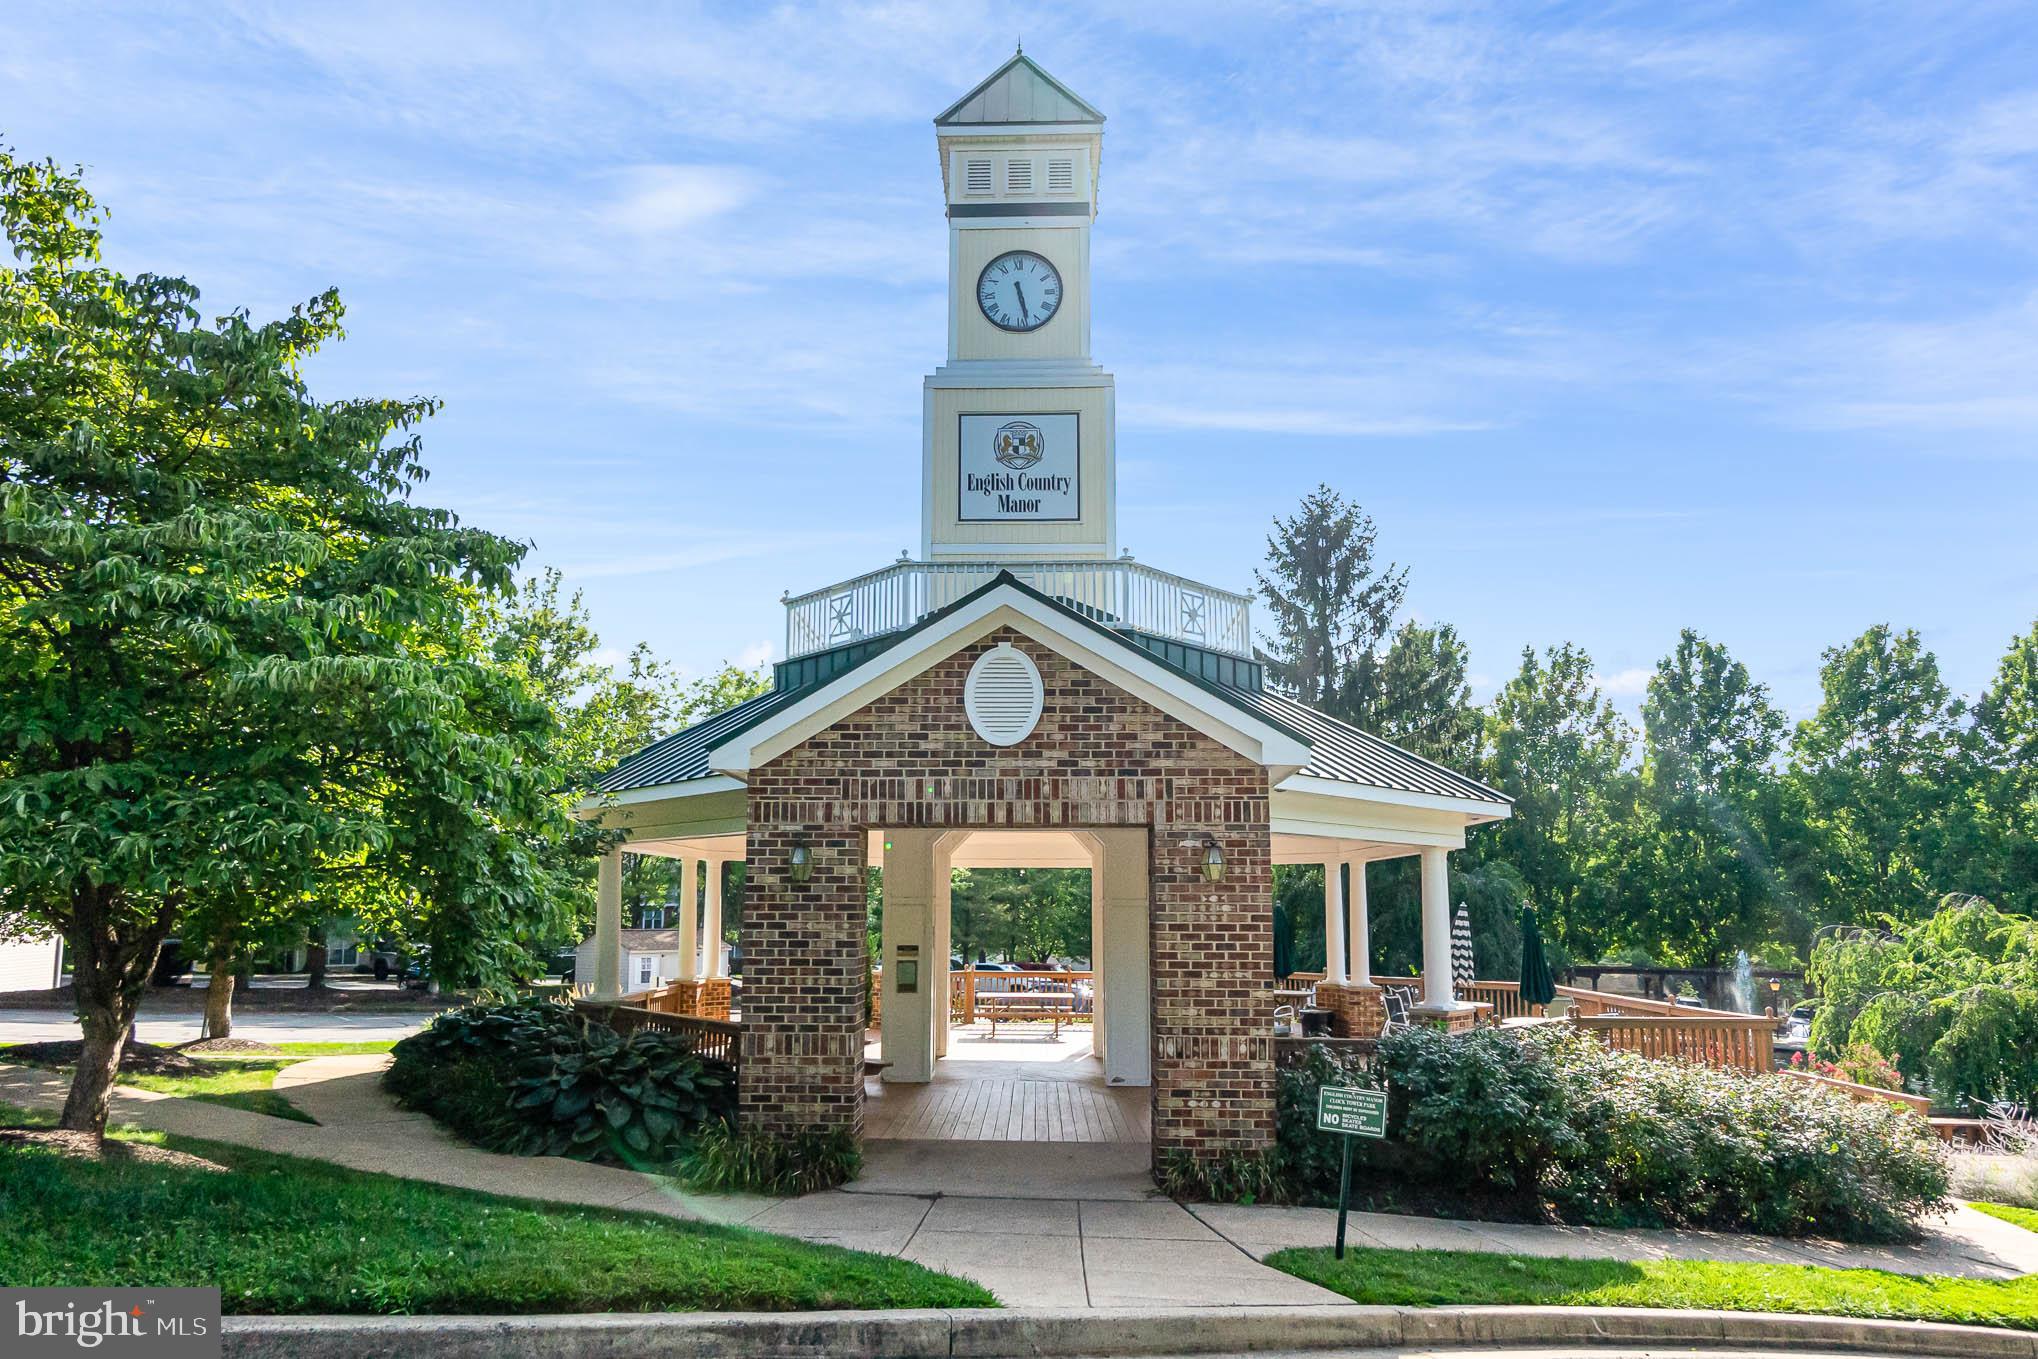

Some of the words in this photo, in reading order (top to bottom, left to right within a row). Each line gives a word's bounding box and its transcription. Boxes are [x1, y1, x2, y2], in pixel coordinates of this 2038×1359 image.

[967, 473, 1014, 496] English
[1018, 472, 1071, 495] Country
[998, 495, 1041, 513] Manor
[1323, 1113, 1339, 1124] NO
